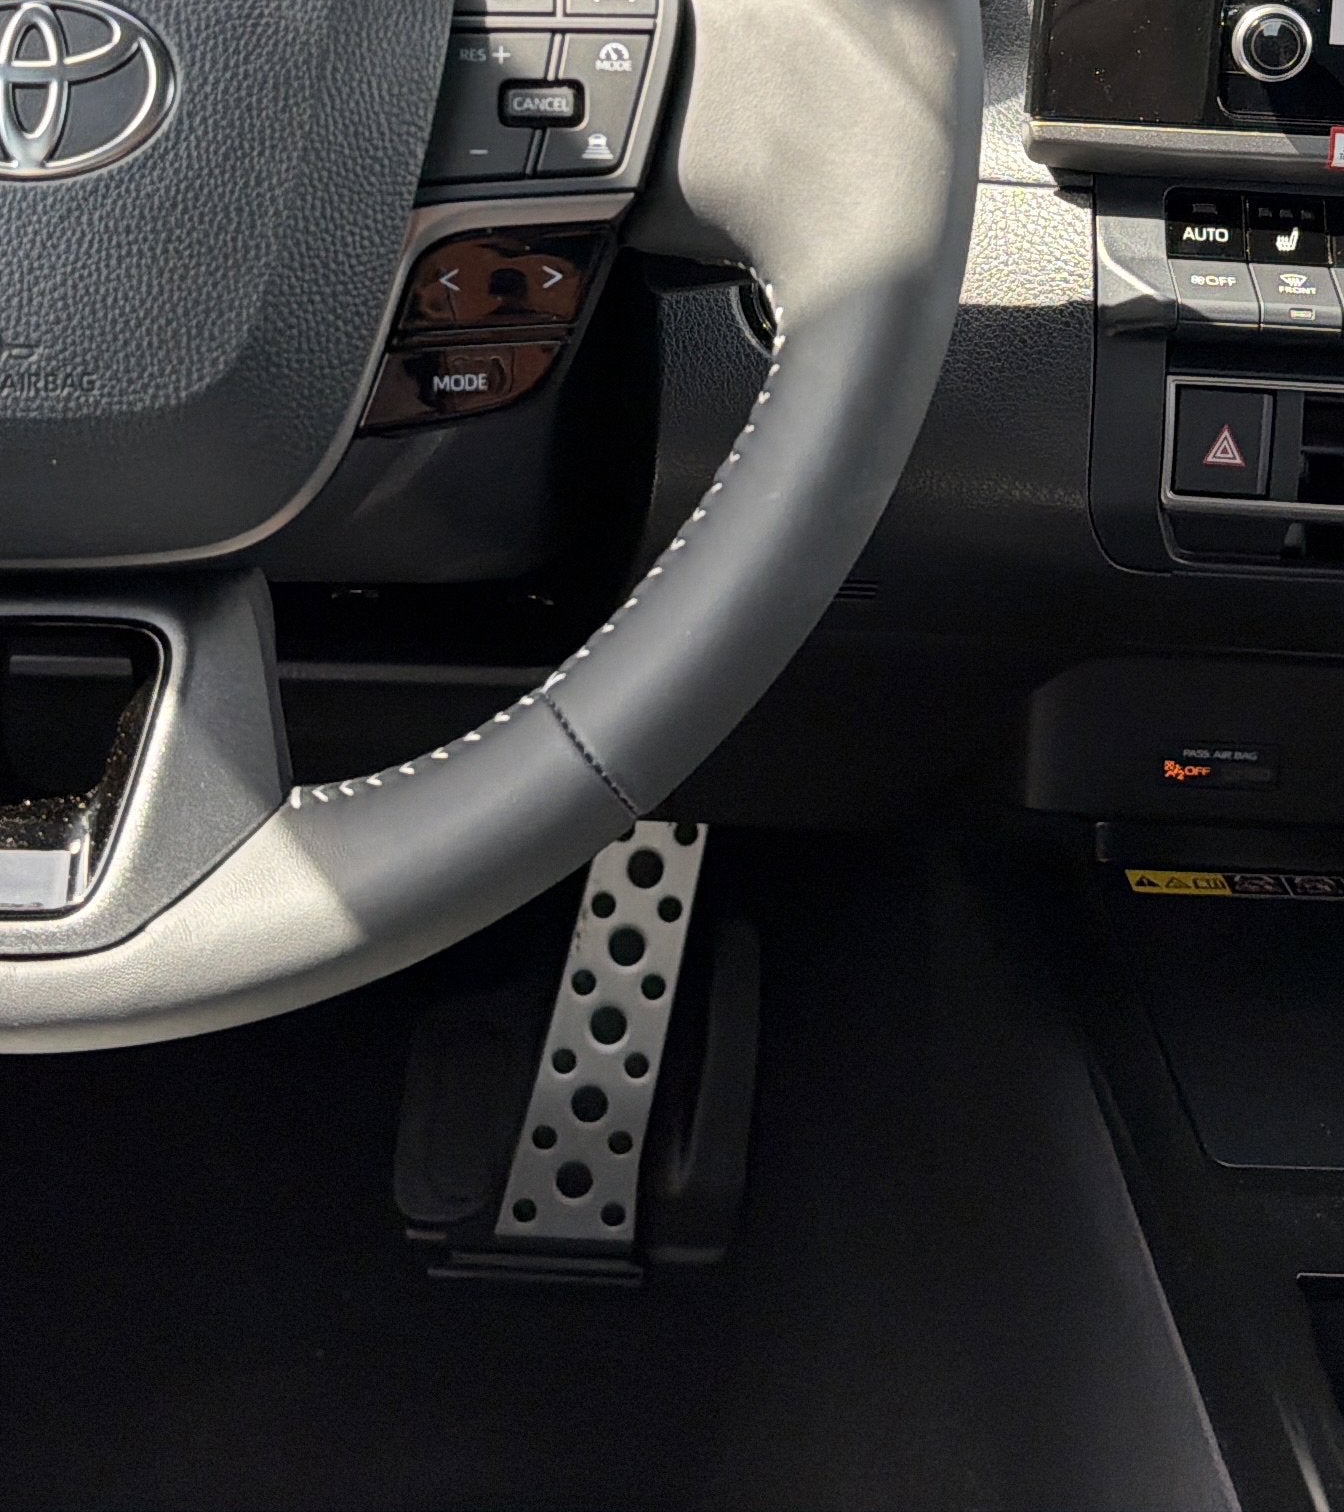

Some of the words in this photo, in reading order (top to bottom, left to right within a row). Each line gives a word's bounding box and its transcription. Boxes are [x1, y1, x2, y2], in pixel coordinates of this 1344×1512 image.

[459, 46, 487, 63] RES
[594, 59, 633, 73] MODE
[511, 94, 570, 113] CANCEL
[1182, 226, 1230, 244] AUTO
[1206, 275, 1237, 287] OFF
[1278, 285, 1317, 295] FRONT
[432, 372, 490, 393] MODE
[1184, 765, 1213, 777] OFF
